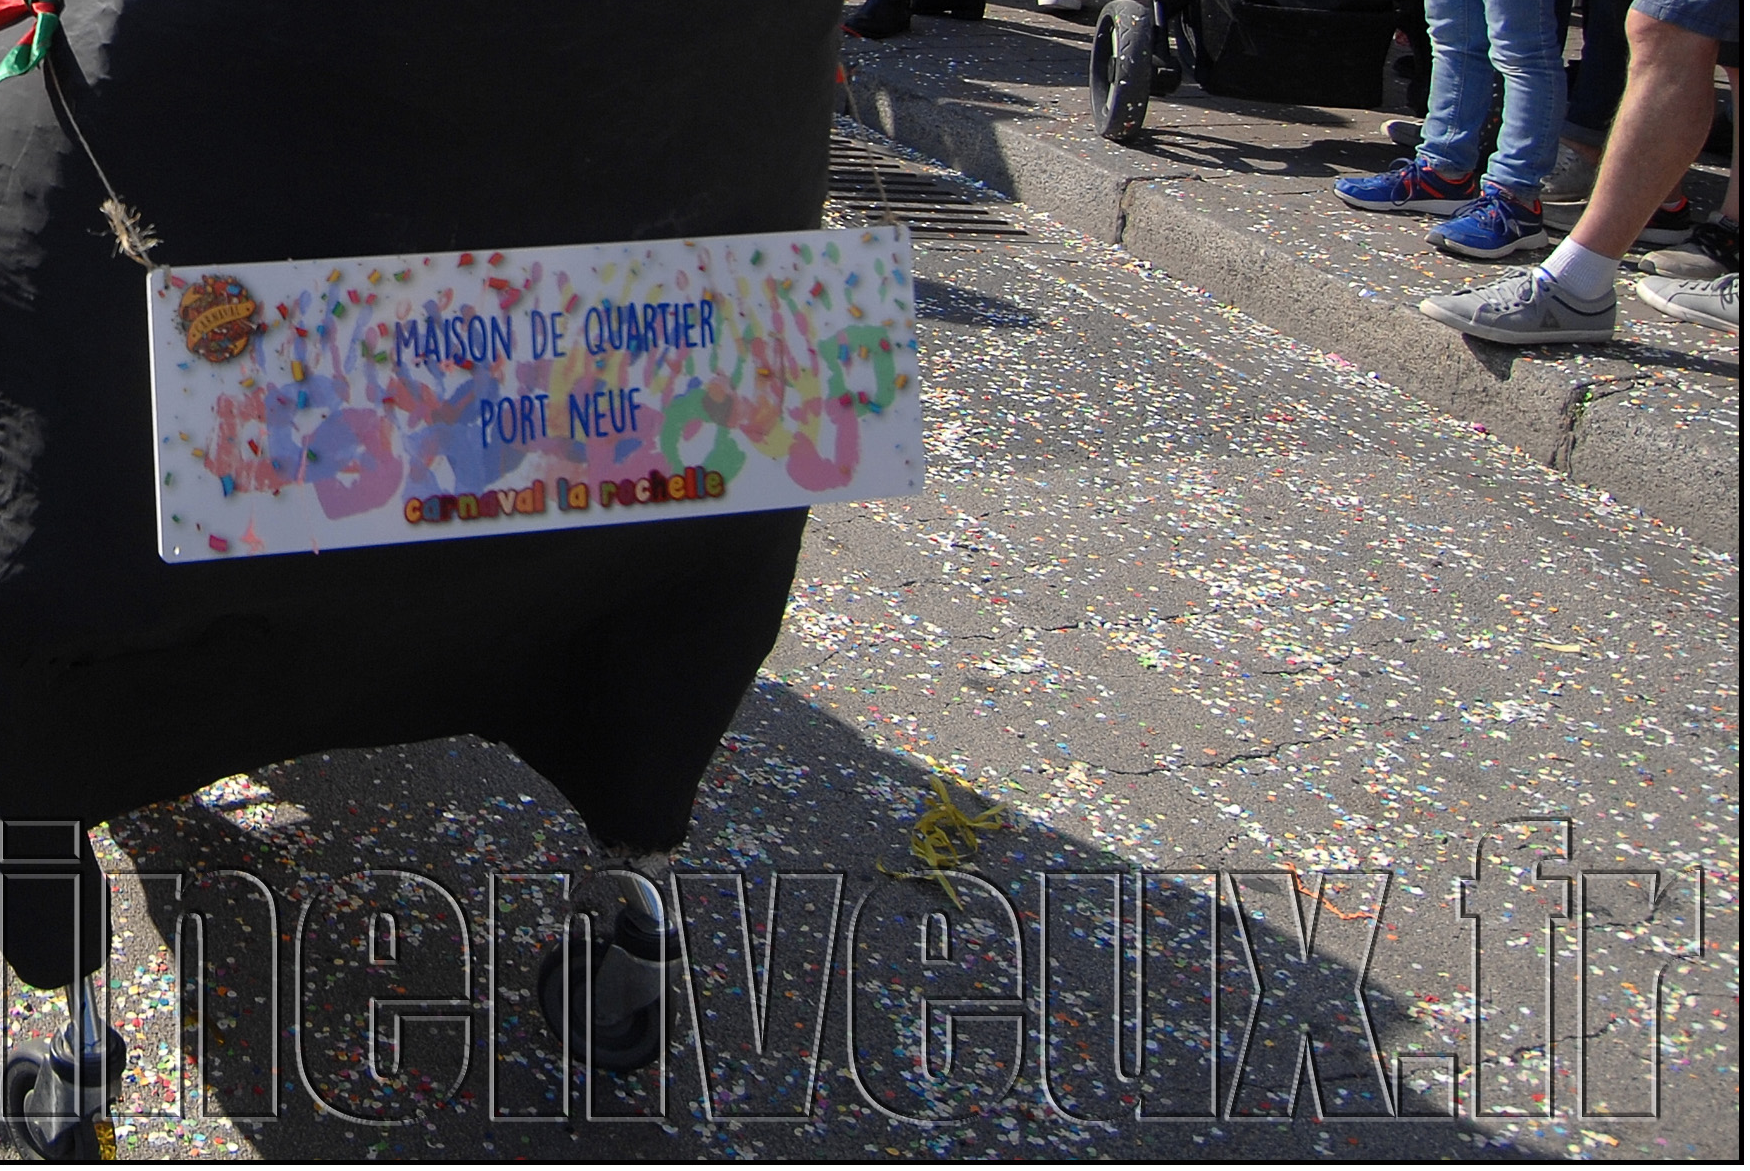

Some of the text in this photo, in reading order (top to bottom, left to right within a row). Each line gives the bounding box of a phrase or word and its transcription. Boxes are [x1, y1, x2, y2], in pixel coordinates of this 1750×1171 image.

[394, 298, 715, 367] MAISON DE QUARTIER
[480, 387, 642, 450] PORT NEUF
[404, 464, 725, 525] carnaval la rochelle
